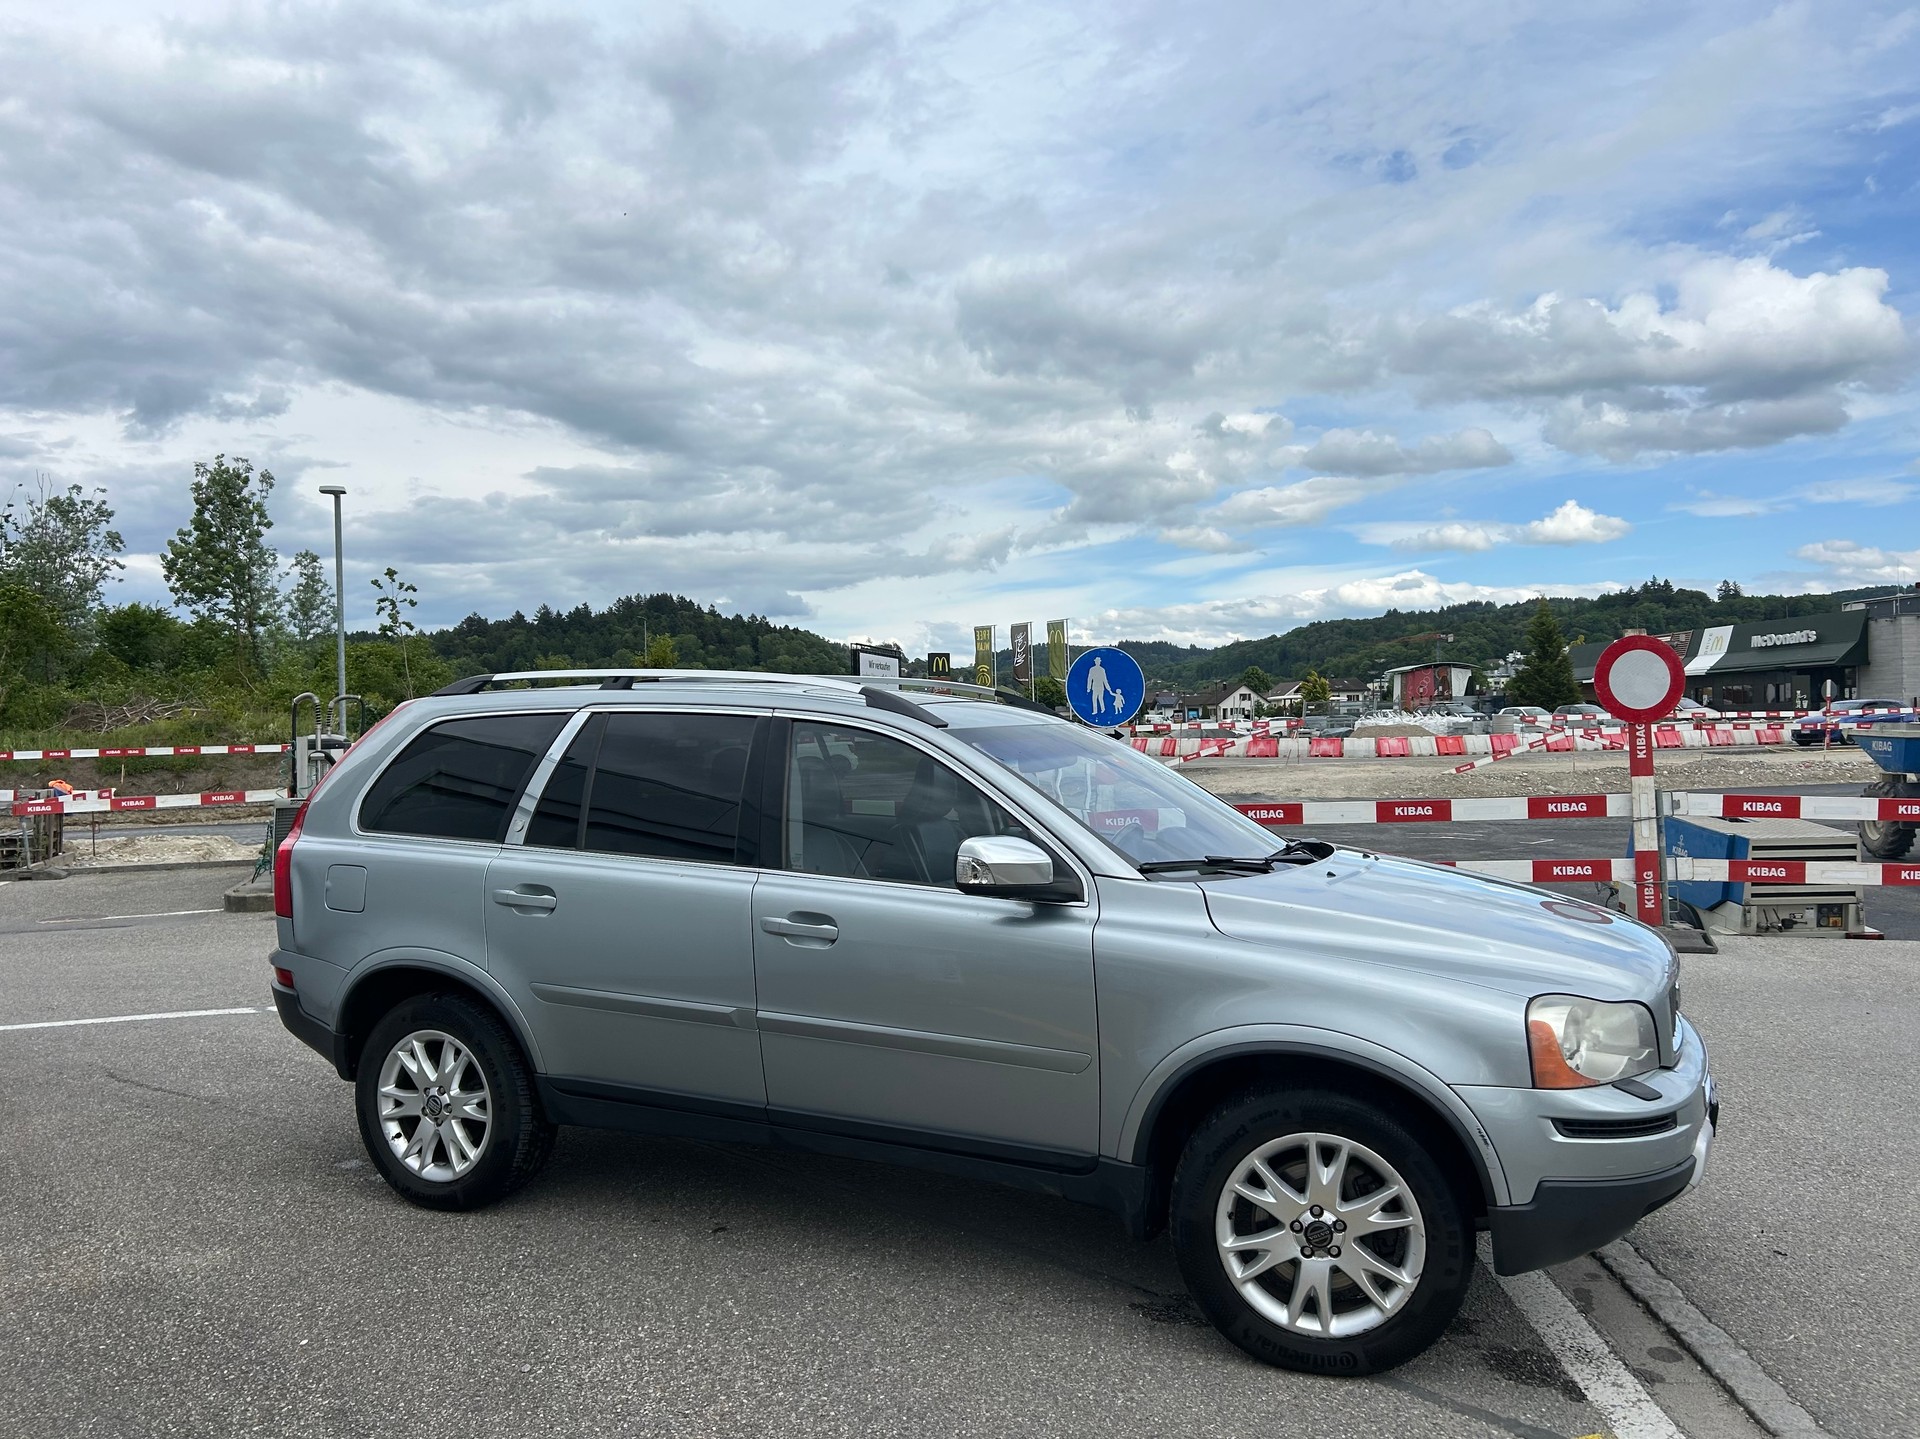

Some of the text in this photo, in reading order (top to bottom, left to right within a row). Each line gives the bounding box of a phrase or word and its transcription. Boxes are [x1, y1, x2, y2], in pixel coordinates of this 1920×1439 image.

[1750, 629, 1817, 648] McDonald's
[1636, 723, 1647, 759] KIBAG
[1872, 741, 1893, 752] KIBAG
[1395, 806, 1433, 817] KIBAG
[1548, 802, 1587, 812] KIBAG
[1743, 801, 1782, 812] KIBAG
[1898, 804, 1920, 815] KIB
[1247, 809, 1284, 819] KIBAG
[1105, 816, 1142, 827] KIBAG
[1553, 866, 1592, 876] KIBAG
[1747, 866, 1786, 877] KIBAG
[1901, 870, 1920, 880] KIB
[1643, 870, 1655, 908] KIBAG
[1308, 1230, 1330, 1240] VOLVO
